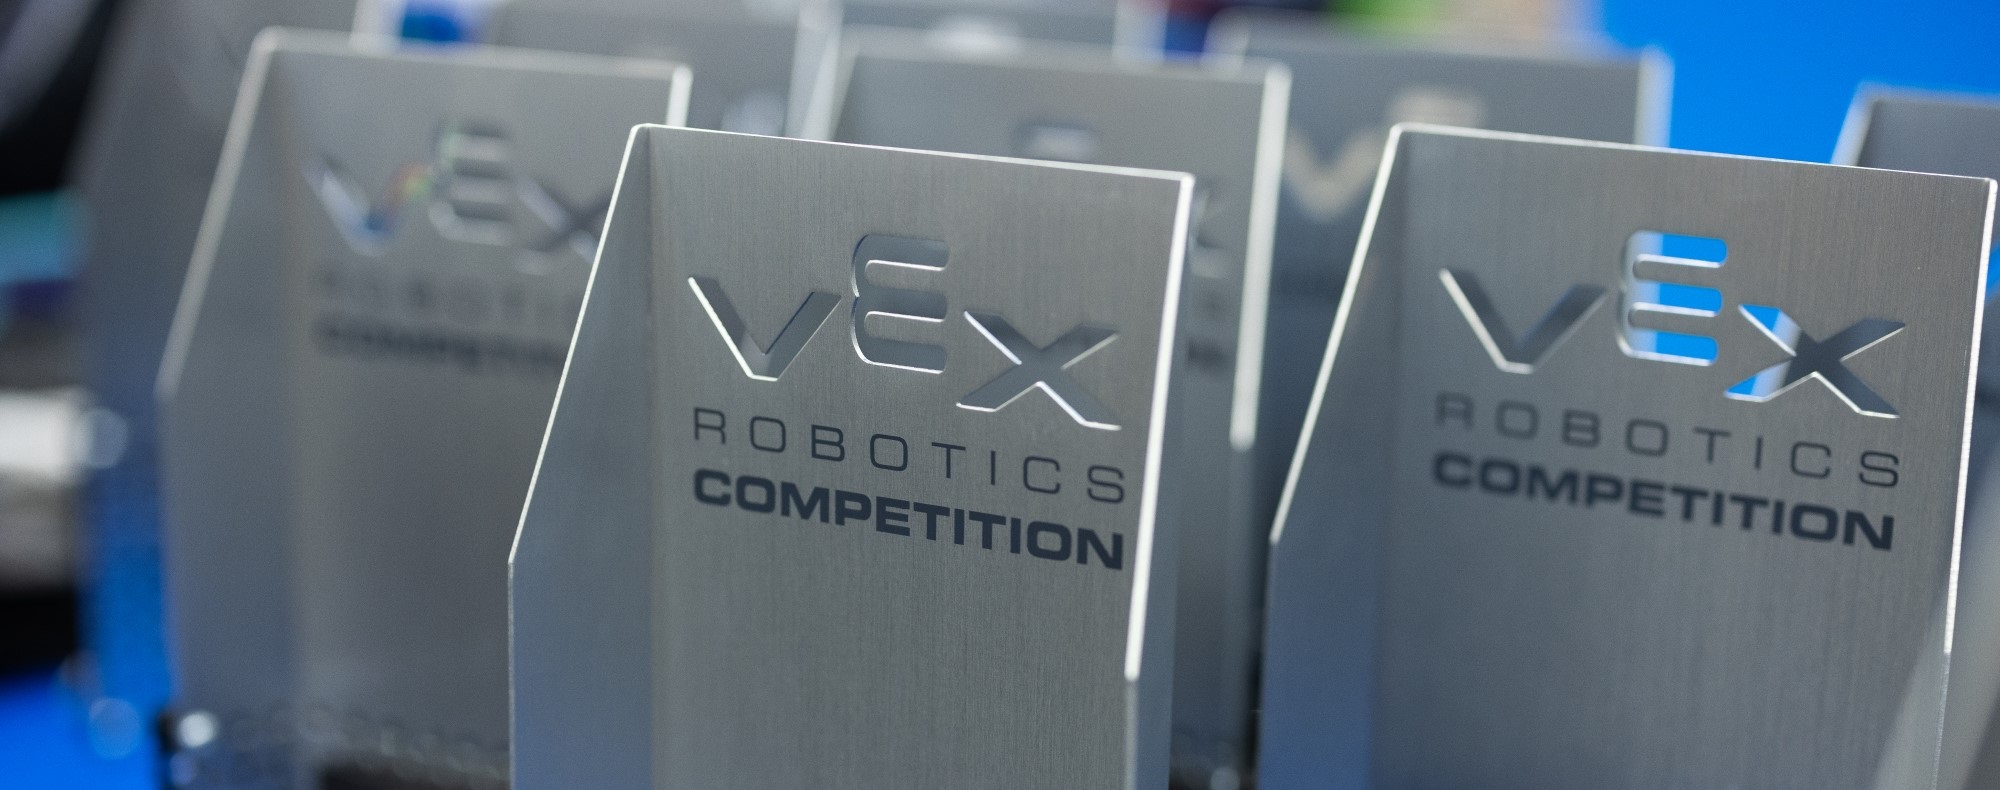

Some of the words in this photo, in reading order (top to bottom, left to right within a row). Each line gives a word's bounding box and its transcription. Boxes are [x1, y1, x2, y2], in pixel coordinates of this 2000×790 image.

[688, 233, 1122, 431] VEX
[1438, 230, 1906, 419] VEX
[692, 406, 1126, 504] ROBOTICS
[1435, 391, 1900, 489] ROBOTICS
[692, 467, 1126, 571] COMPETITION
[1432, 449, 1896, 552] COMPETITION
